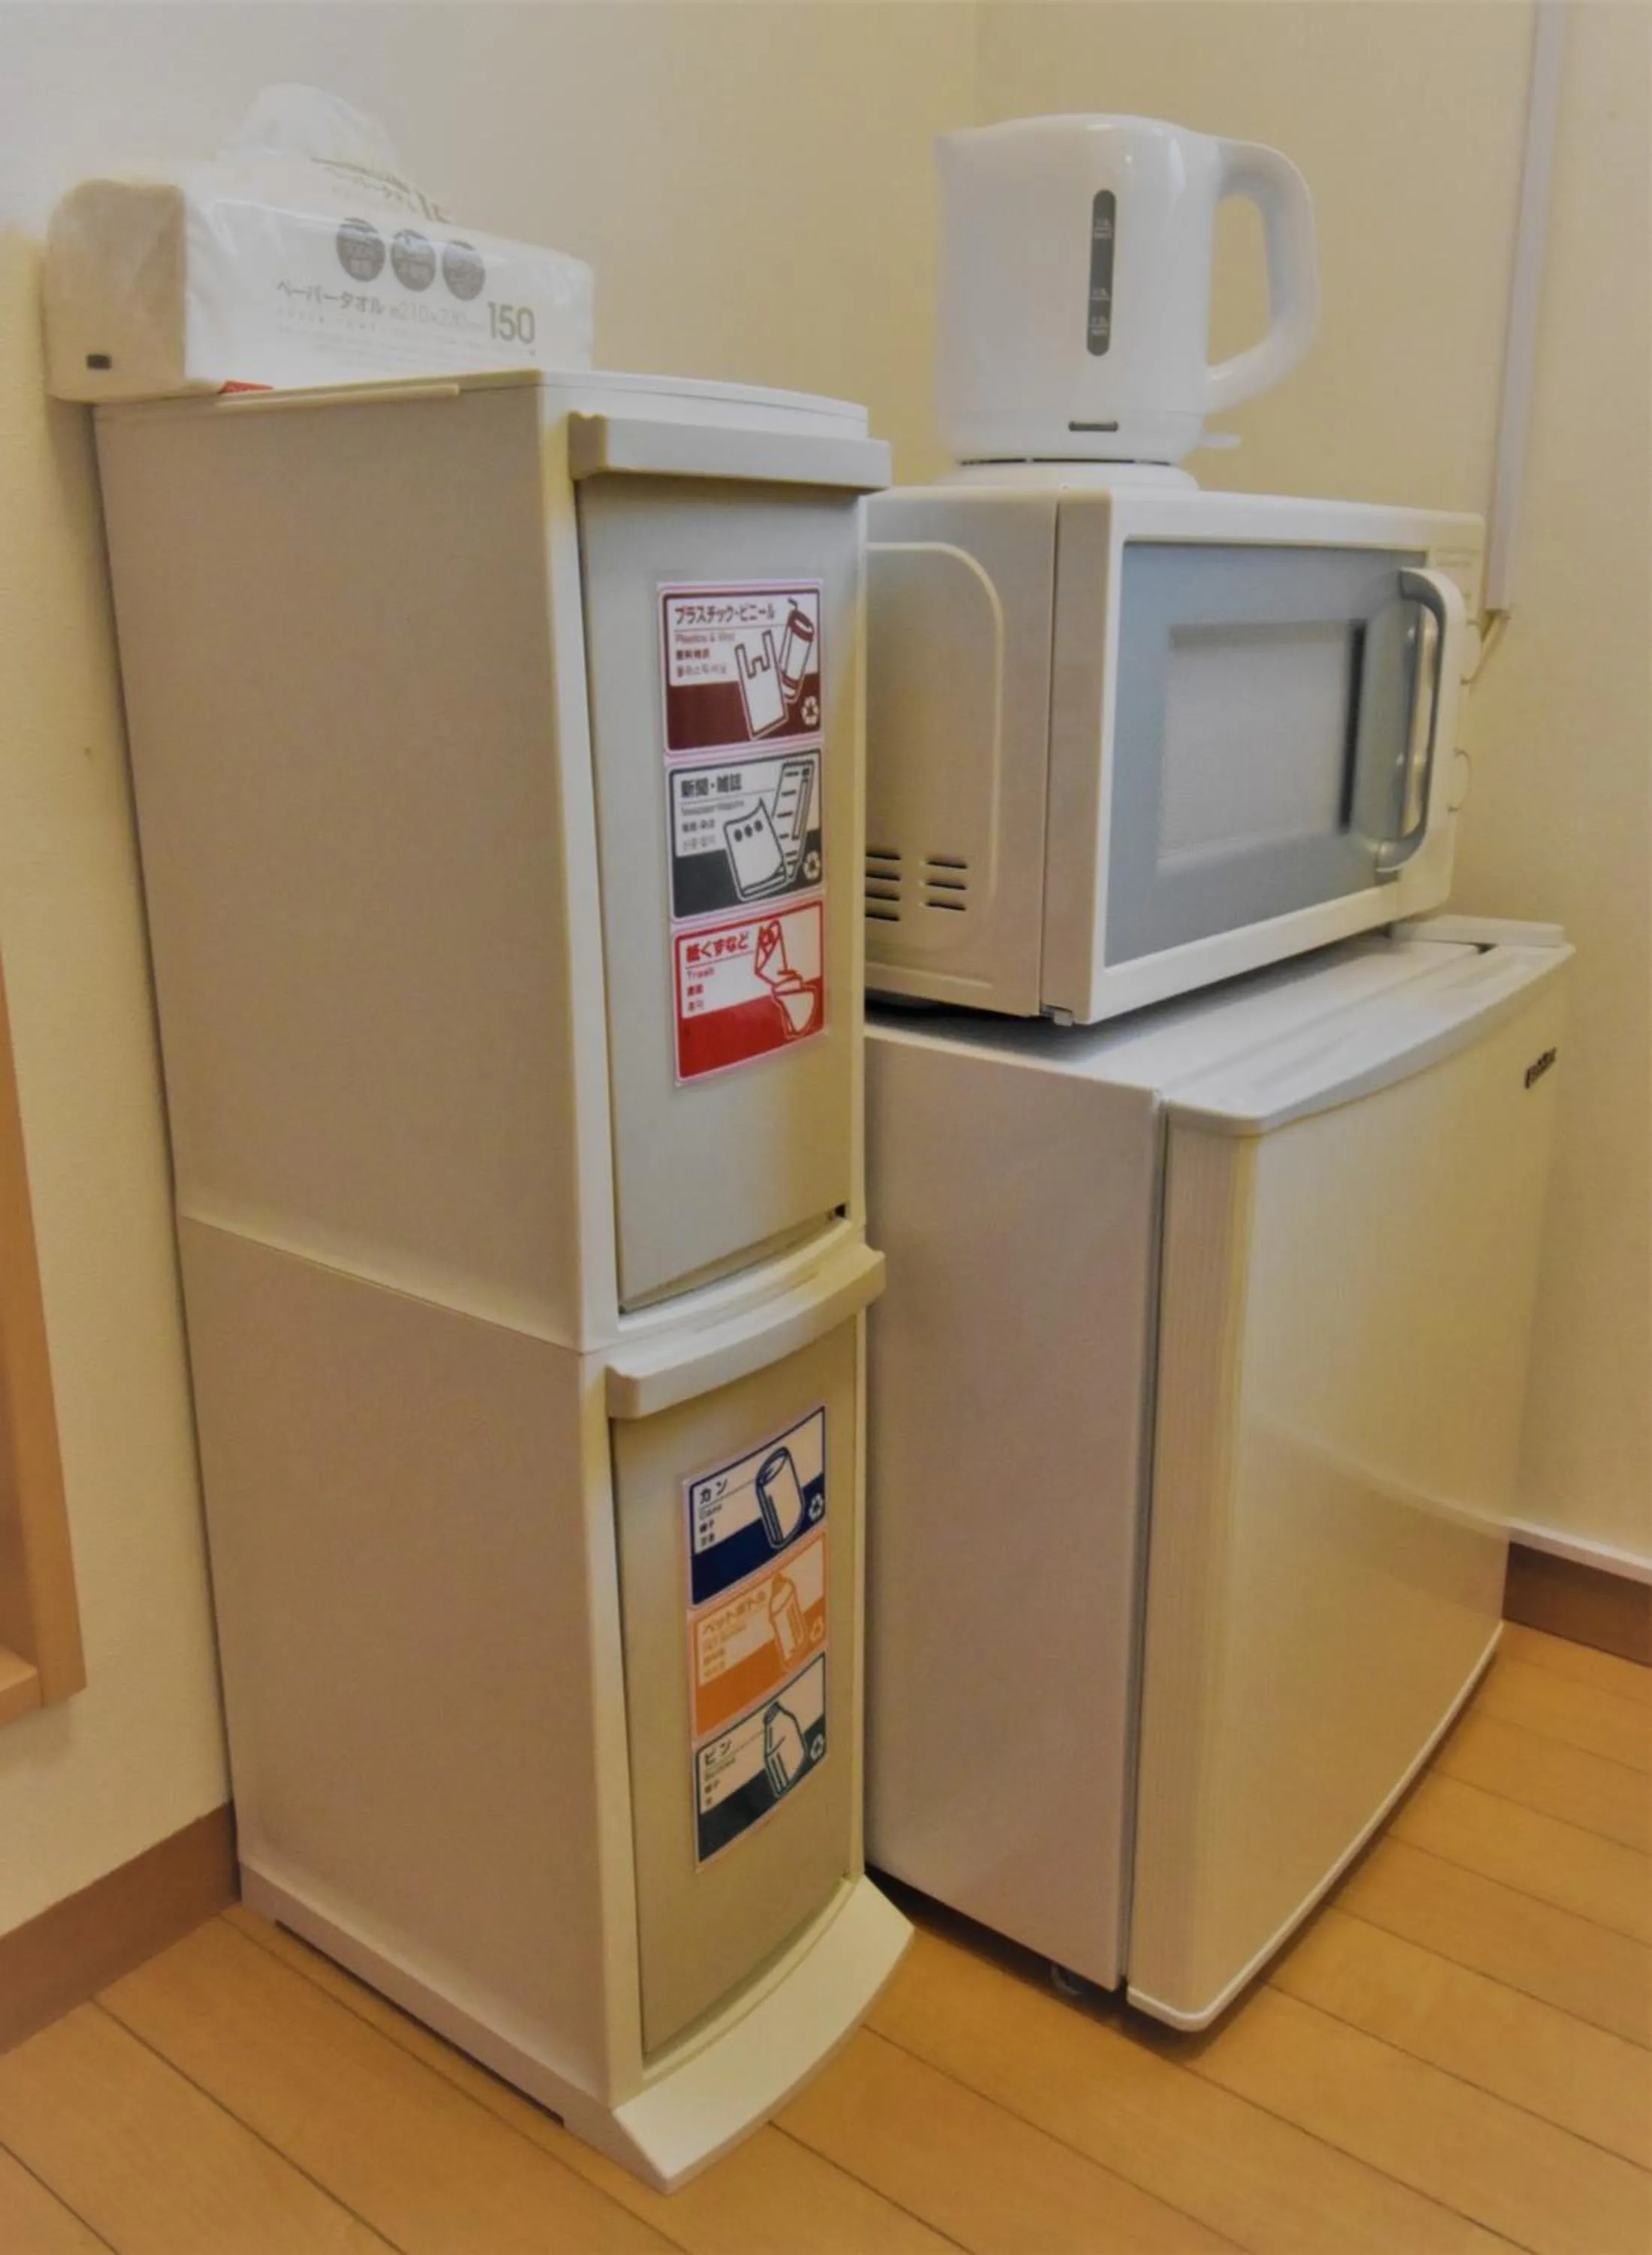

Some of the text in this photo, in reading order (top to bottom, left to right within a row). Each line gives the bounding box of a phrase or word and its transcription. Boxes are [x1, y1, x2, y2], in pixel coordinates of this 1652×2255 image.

[277, 279, 385, 316] ペーパータオル
[487, 301, 536, 344] 150
[675, 602, 775, 625] プラスチック・ビニール
[700, 1479, 728, 1504] カン
[704, 1739, 732, 1766] ビン
